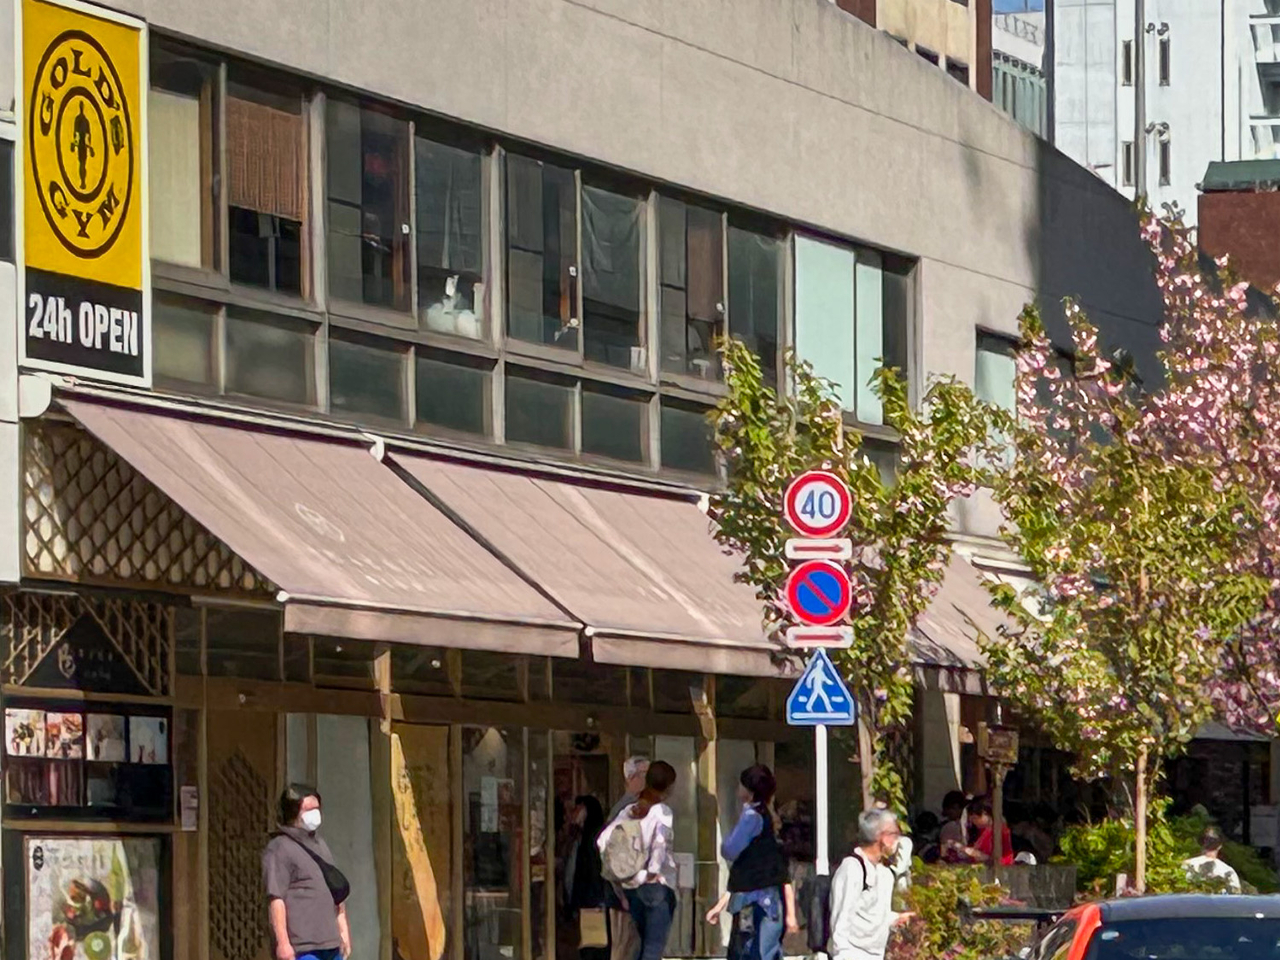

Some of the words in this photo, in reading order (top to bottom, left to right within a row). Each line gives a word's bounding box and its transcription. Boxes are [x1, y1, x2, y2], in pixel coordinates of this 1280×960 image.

[49, 181, 120, 239] GYM
[29, 293, 72, 344] 24h
[79, 301, 138, 356] OPEN
[801, 489, 836, 520] 40
